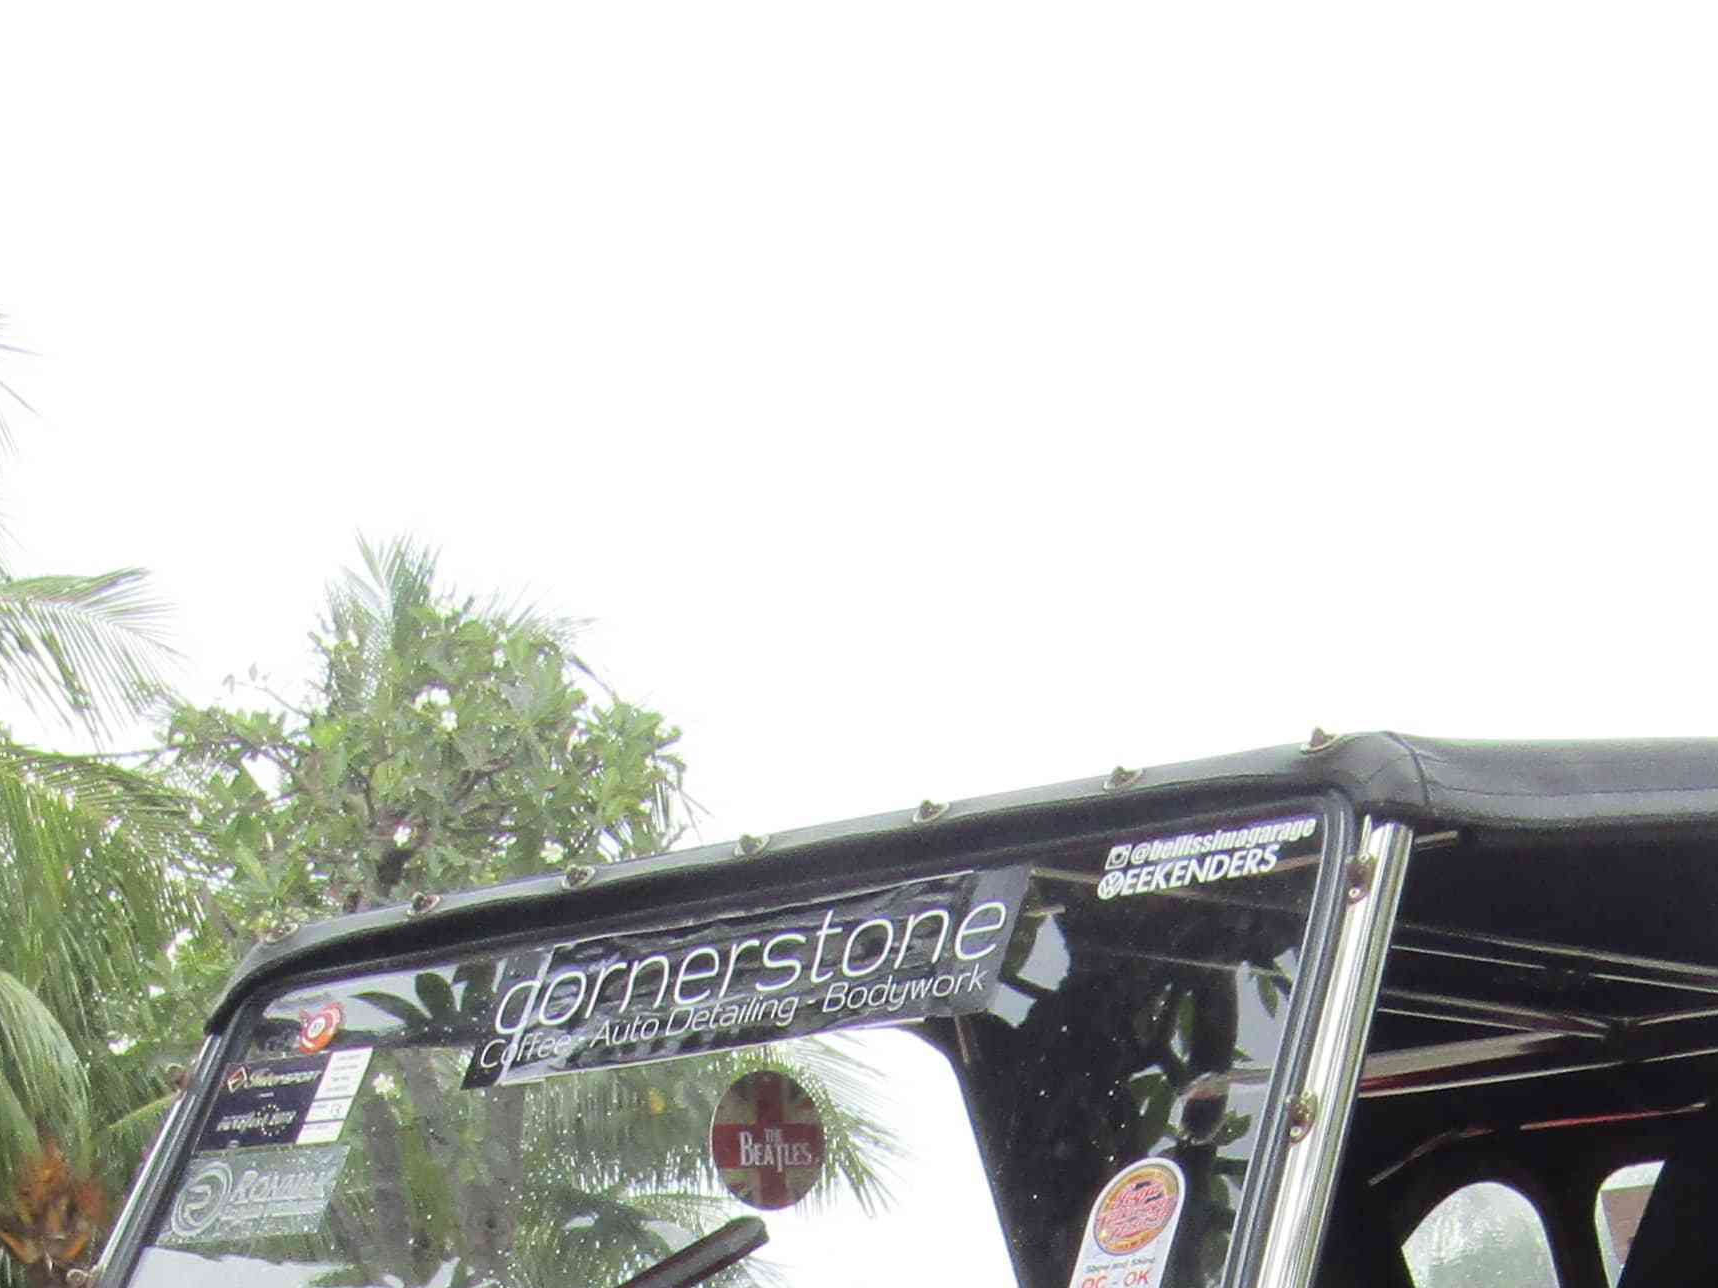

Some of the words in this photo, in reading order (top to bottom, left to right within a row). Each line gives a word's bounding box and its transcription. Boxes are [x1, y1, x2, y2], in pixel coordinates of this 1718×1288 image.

[589, 1012, 660, 1049] Auto
[666, 994, 799, 1038] Detailing
[822, 964, 989, 1020] Bodywork
[1123, 1269, 1149, 1287] OK
